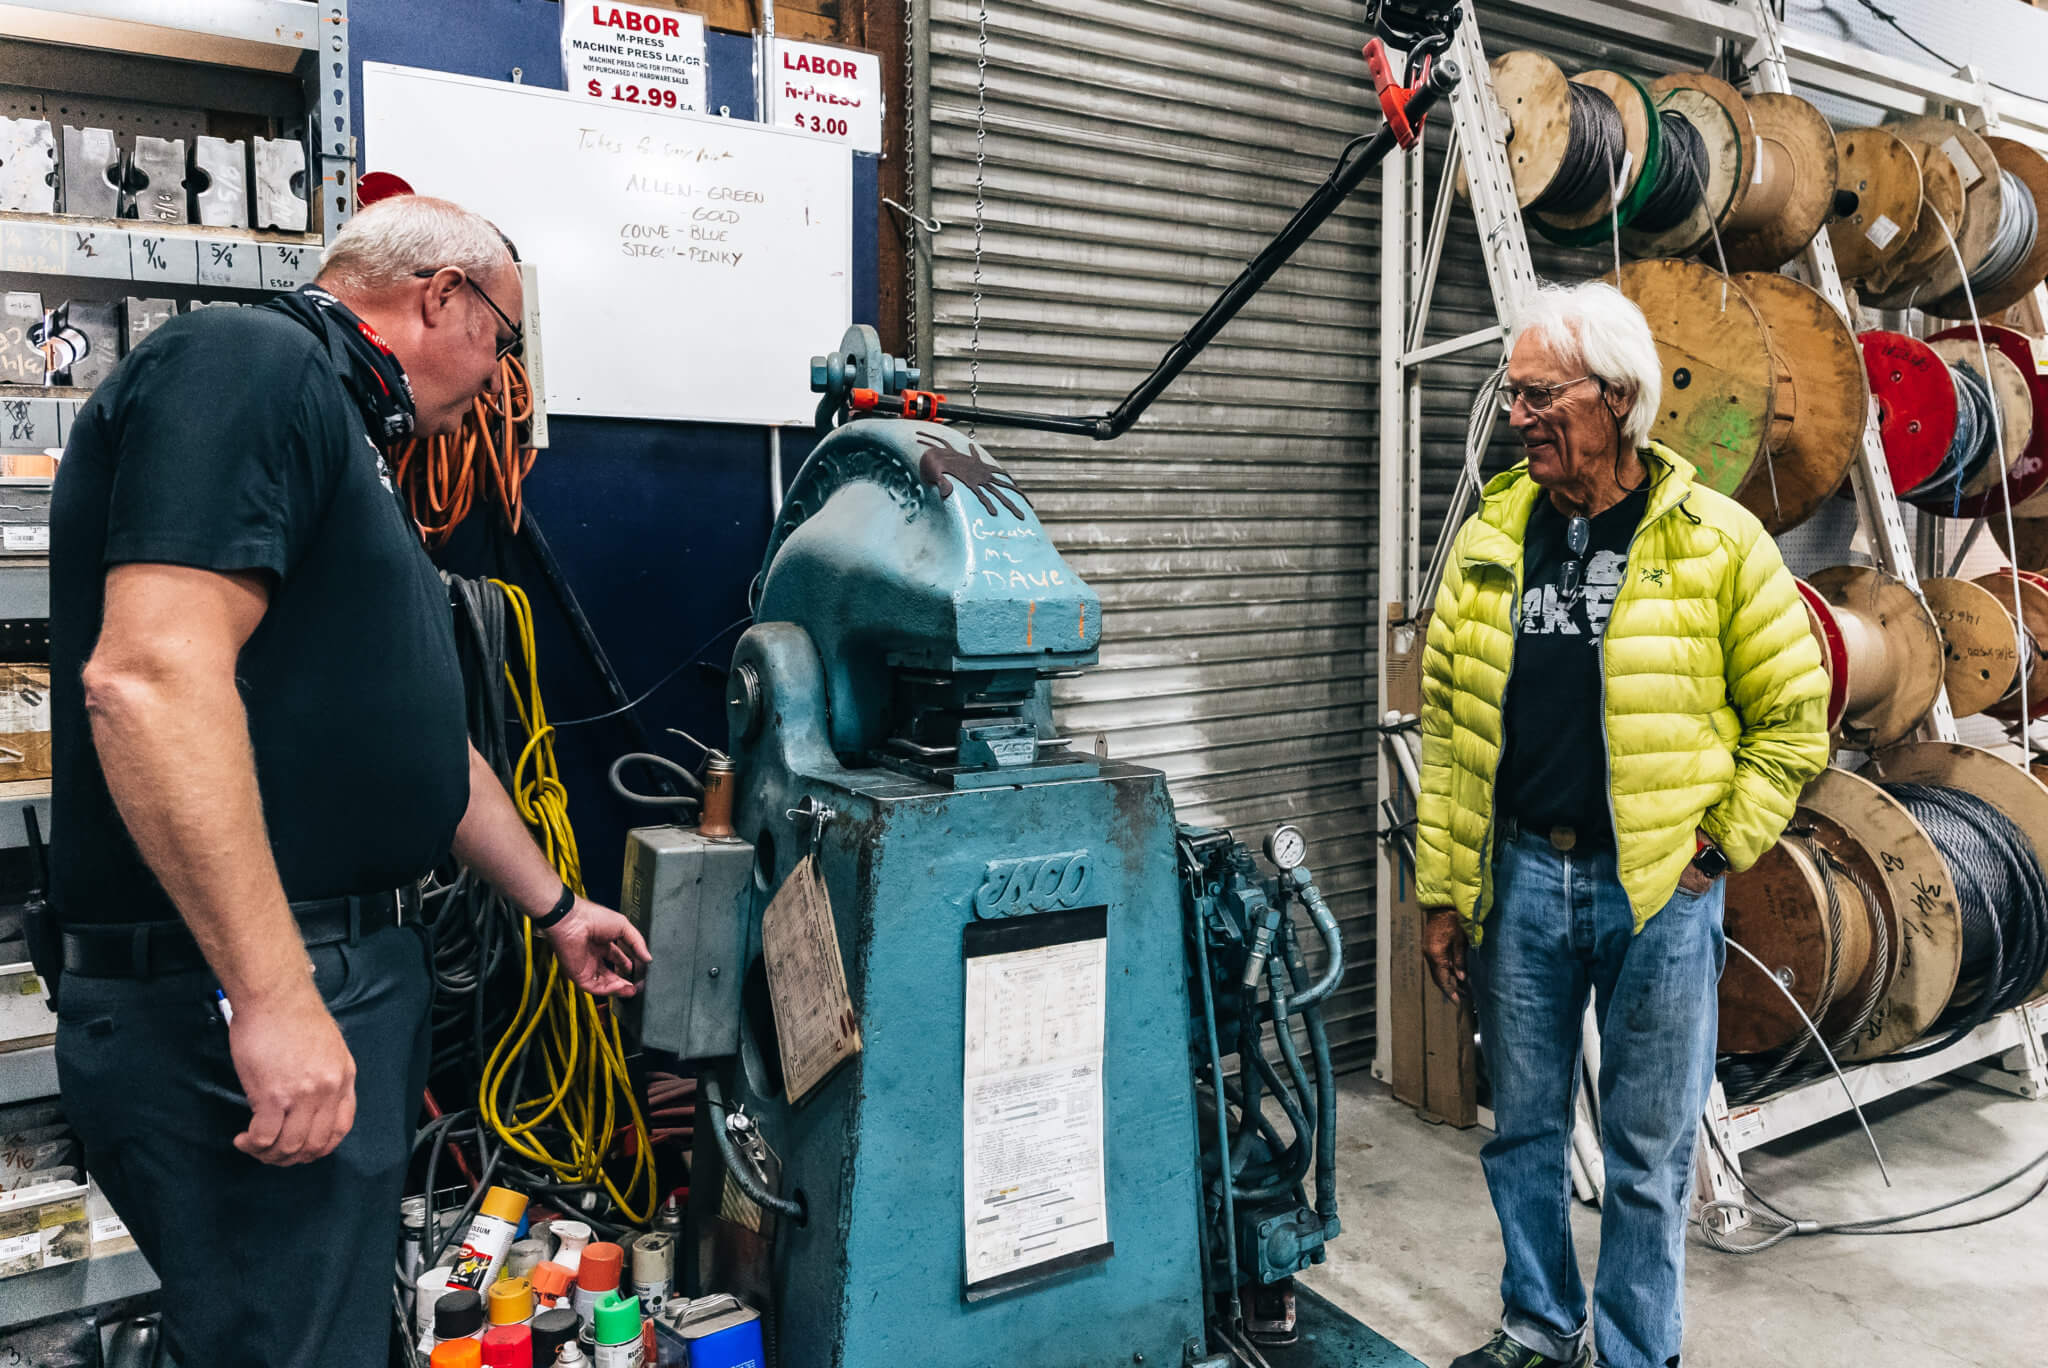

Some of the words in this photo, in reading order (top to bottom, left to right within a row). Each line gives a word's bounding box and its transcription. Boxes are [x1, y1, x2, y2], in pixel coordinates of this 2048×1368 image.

[592, 5, 680, 37] LABOR
[572, 40, 624, 56] MACHINE
[627, 48, 663, 62] PRESS
[616, 33, 665, 48] M-PRESS
[583, 64, 594, 72] NOT
[596, 66, 631, 78] PURCHASED
[639, 72, 671, 83] HARDWARE
[671, 76, 689, 85] SALES
[588, 55, 616, 66] MACHINE
[616, 59, 636, 69] PRESS
[649, 63, 661, 72] FOR
[661, 66, 686, 76] FITTINGS
[783, 51, 857, 80] LABOR
[587, 78, 603, 98] $
[610, 84, 678, 109] 12.99
[810, 115, 848, 136] 3.00
[707, 186, 764, 203] GREEN
[691, 206, 740, 224] GOLD
[690, 224, 729, 242] BLUE
[688, 246, 744, 267] PINKY
